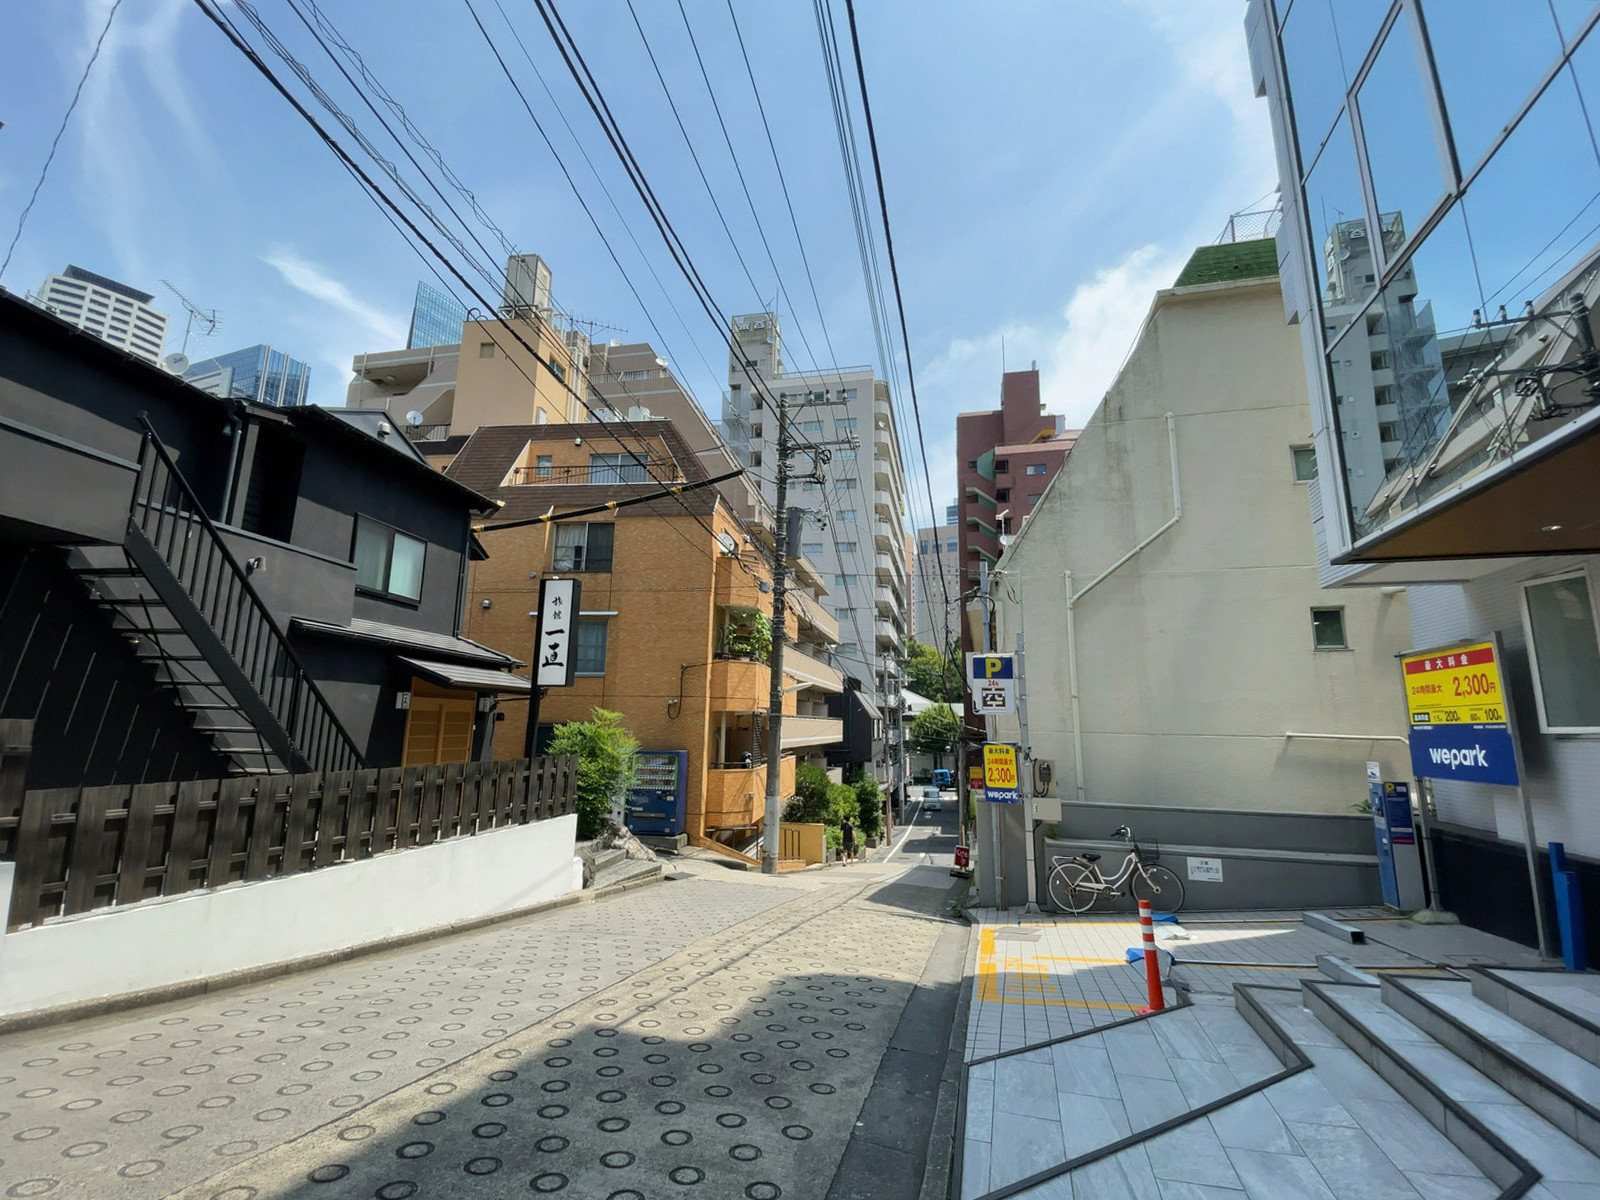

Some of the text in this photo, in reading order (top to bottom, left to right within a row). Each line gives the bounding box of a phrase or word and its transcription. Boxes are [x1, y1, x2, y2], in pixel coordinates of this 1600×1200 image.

[986, 658, 1002, 678] P
[1425, 654, 1468, 670] 最大料金
[1411, 673, 1495, 698] 24時間最大 2,300円
[982, 687, 1006, 710] 空
[1429, 744, 1489, 770] wepark
[987, 767, 1015, 784] 2,300円
[986, 790, 1018, 800] wepark
